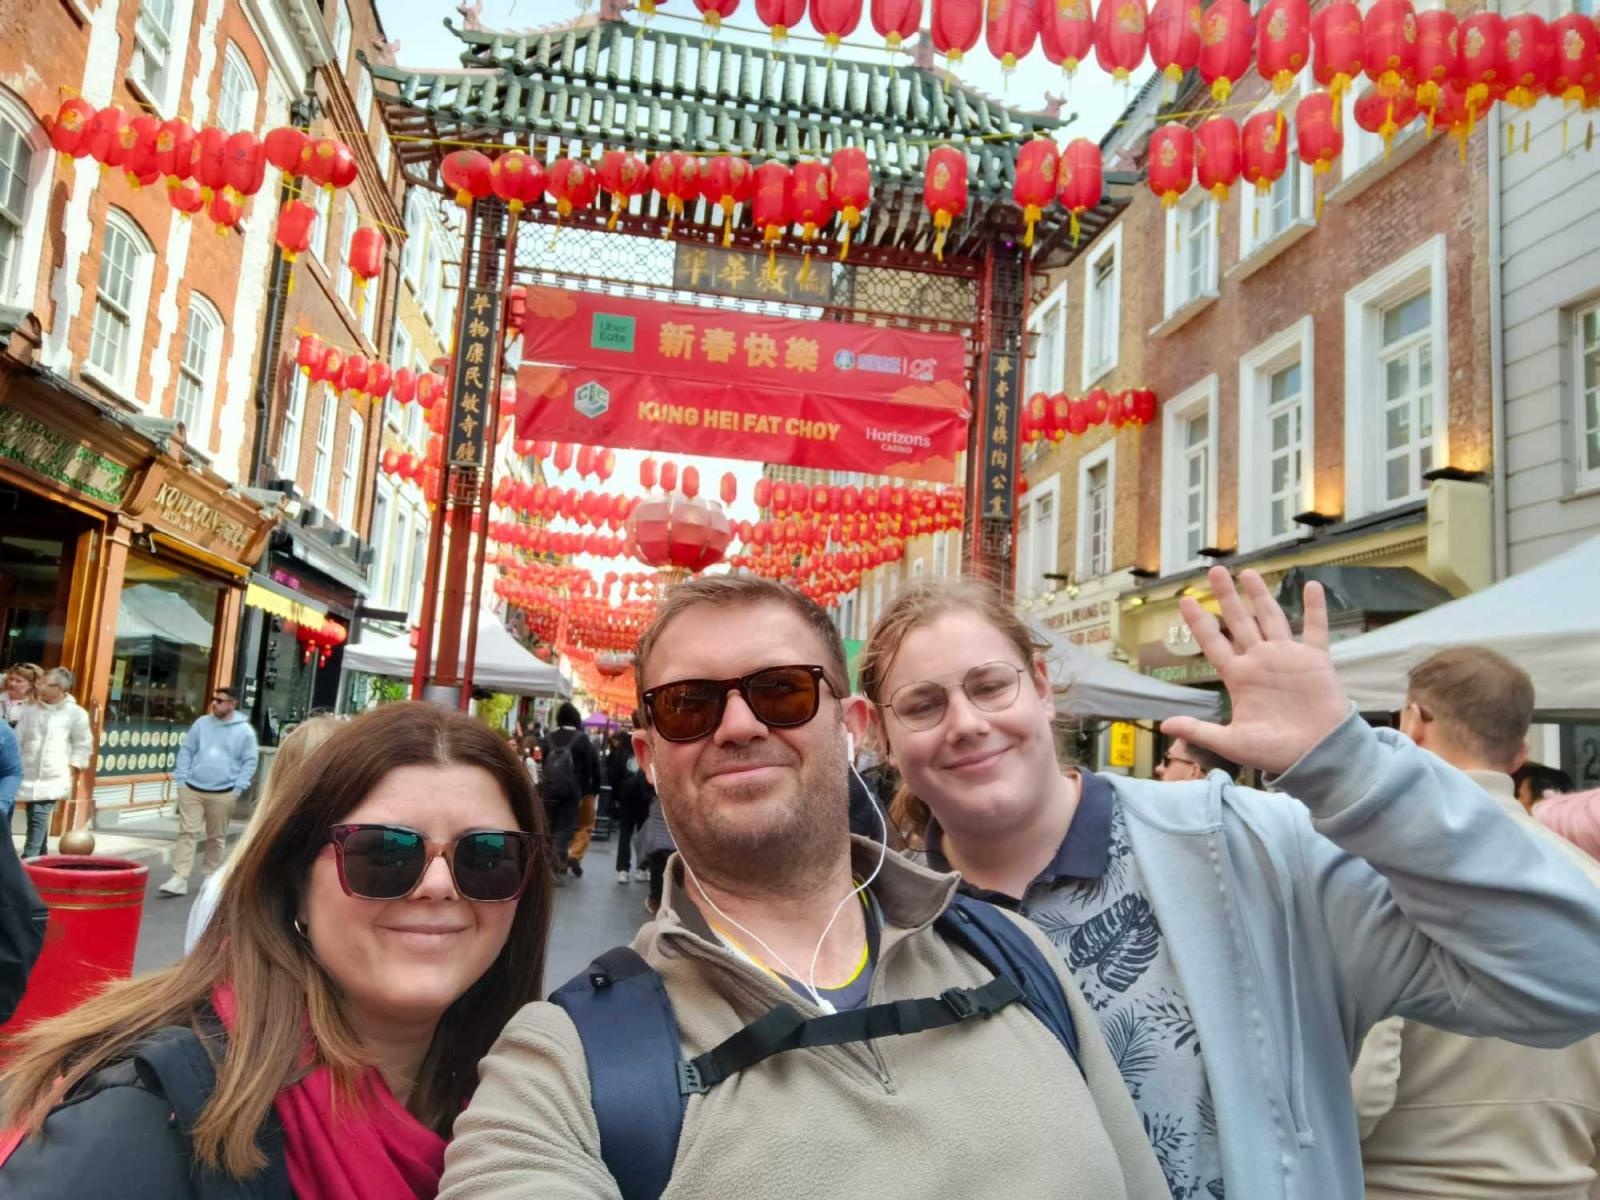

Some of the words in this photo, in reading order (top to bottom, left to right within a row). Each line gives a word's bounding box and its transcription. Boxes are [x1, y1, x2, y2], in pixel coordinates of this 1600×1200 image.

[599, 330, 626, 344] Eats
[658, 321, 820, 373] 新春快樂
[637, 400, 699, 426] KUNG
[703, 411, 740, 431] HEI
[743, 414, 784, 435] FAT
[785, 418, 842, 441] CHOY
[865, 426, 932, 448] Horizons
[154, 482, 222, 531] KOWLOON
